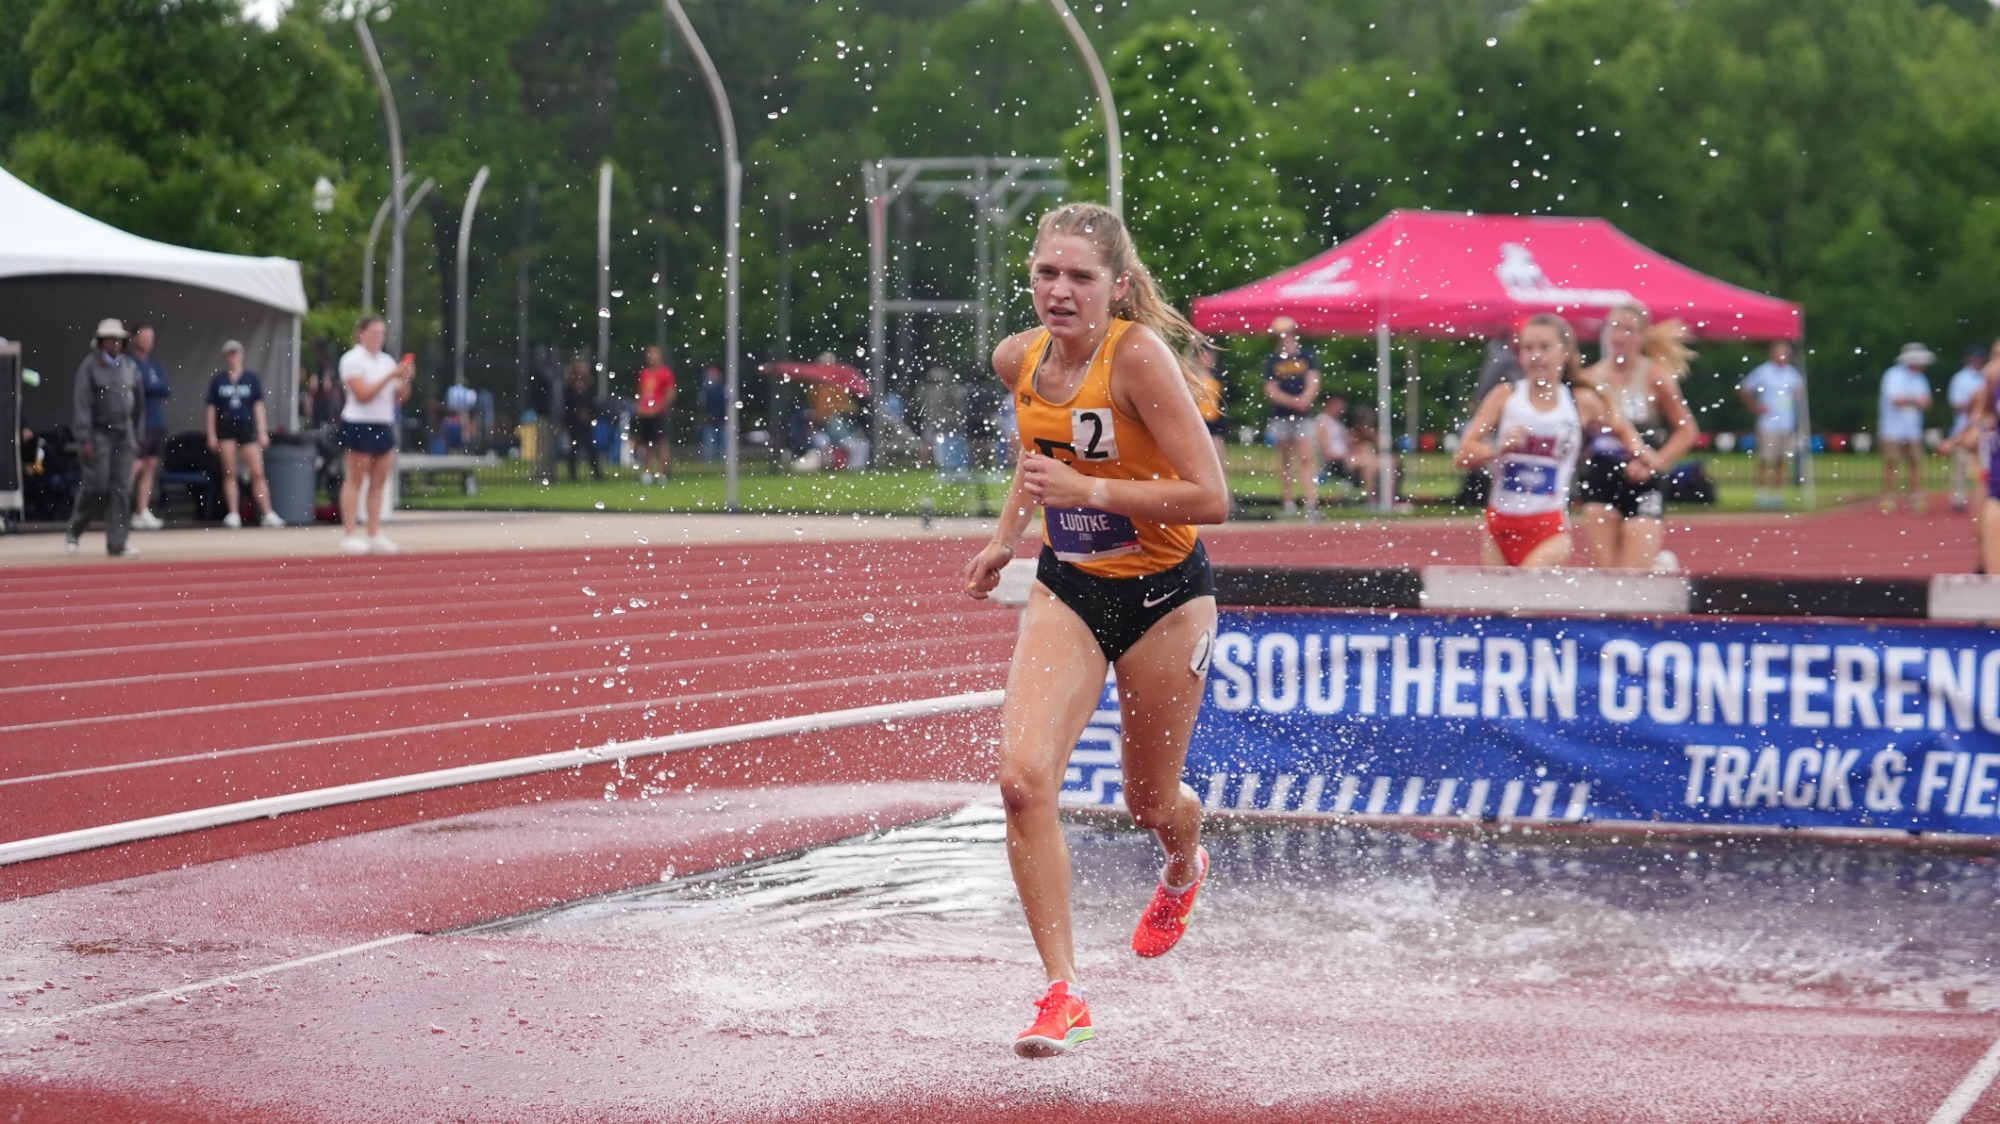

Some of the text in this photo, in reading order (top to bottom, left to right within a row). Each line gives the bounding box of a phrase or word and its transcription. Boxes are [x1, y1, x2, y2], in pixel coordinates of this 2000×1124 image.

[1080, 412, 1109, 458] 2
[1060, 512, 1110, 532] LUDTKE
[1213, 631, 1577, 720] SOUTHERN
[1684, 745, 2000, 817] TRACK & FIE
